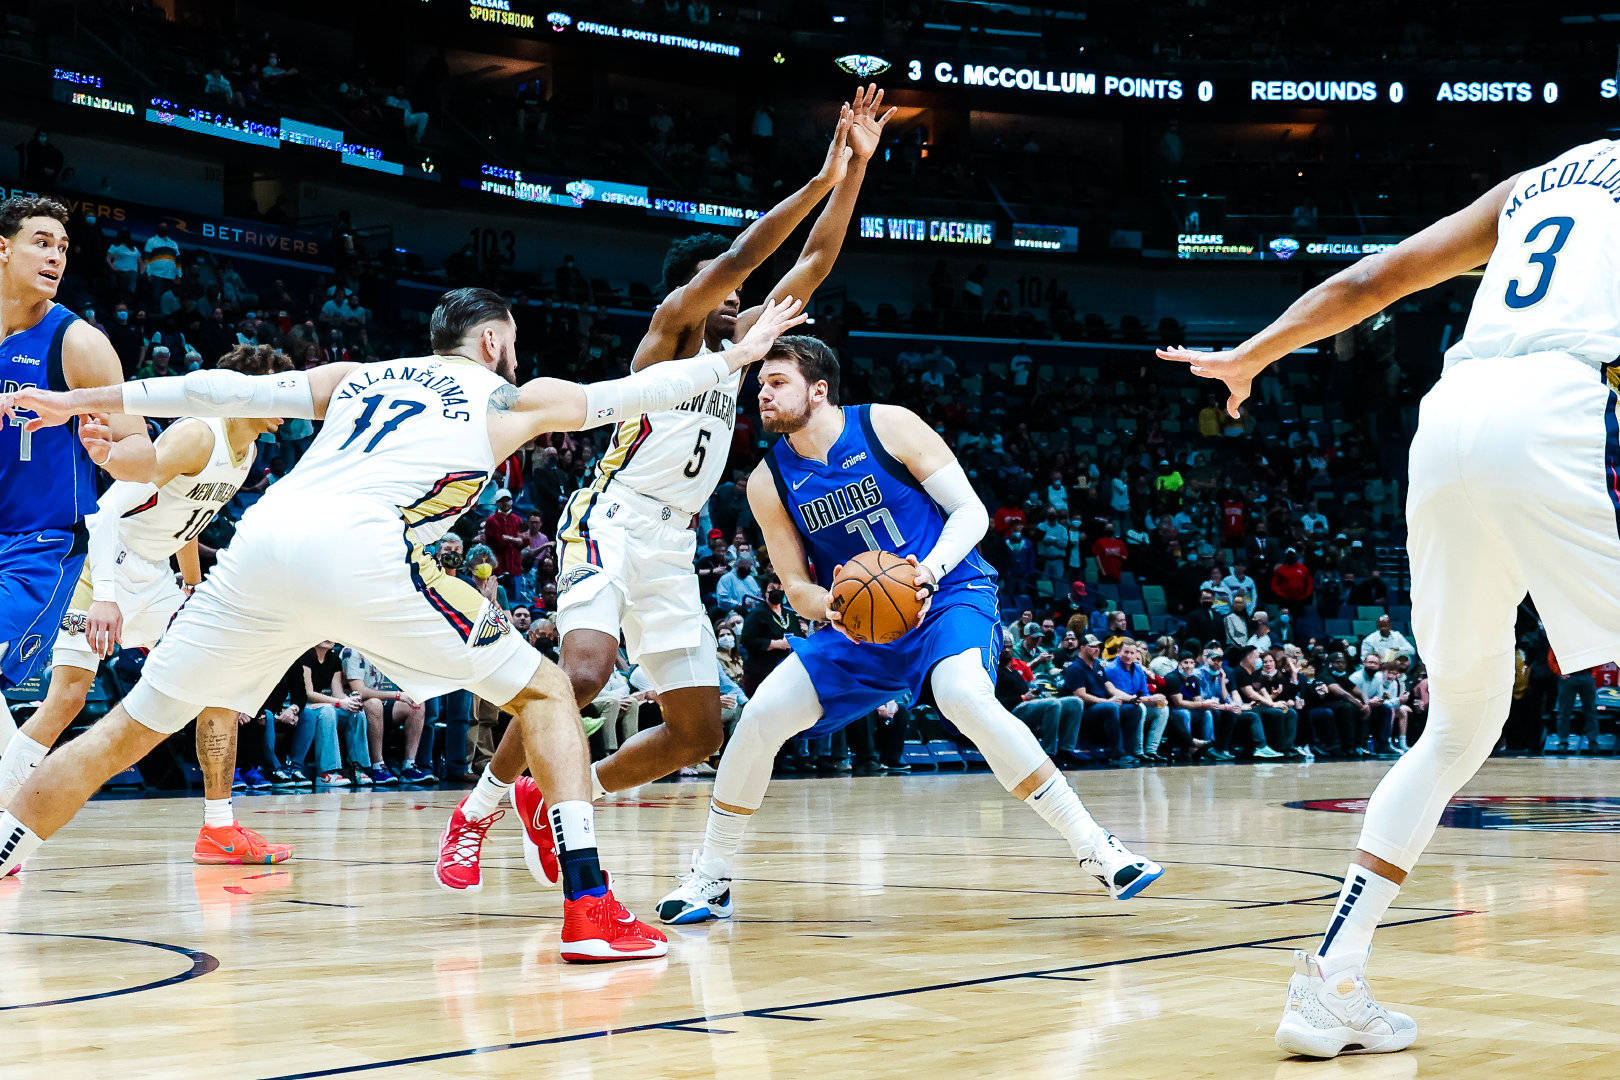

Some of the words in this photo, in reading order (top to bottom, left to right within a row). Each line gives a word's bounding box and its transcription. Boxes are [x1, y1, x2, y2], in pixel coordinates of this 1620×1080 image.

[470, 5, 535, 29] SPORTSBOOK
[577, 21, 619, 37] OFFICIAL
[621, 28, 658, 43] SPORTS
[659, 34, 699, 50] BETTING
[699, 40, 741, 57] PARTNER
[908, 60, 921, 80] 3
[935, 62, 958, 83] C.
[964, 64, 1096, 95] MCCOLLUM
[1104, 75, 1183, 100] POINTS
[1197, 80, 1213, 102] 0
[1251, 80, 1377, 102] REBOUNDS
[1389, 81, 1404, 103] 0
[1437, 81, 1533, 103] ASSISTS
[1543, 82, 1559, 104] 0
[601, 191, 652, 209] OFFICIAL
[654, 198, 697, 215] SPORTS
[698, 203, 744, 220] BETTING
[203, 221, 322, 261] BETRIVERS
[471, 227, 517, 267] 103
[888, 217, 926, 242] WITH
[930, 220, 993, 245] CAESARS
[1178, 233, 1224, 245] CAESARS
[1306, 242, 1361, 255] OFFICIAL
[1504, 215, 1577, 310] 3
[12, 353, 41, 367] chime
[338, 393, 428, 454] 17
[683, 428, 712, 480] 5
[842, 451, 869, 469] chime
[185, 482, 217, 501] NEW
[798, 474, 883, 535] DALLAS
[173, 507, 215, 543] 10
[844, 507, 906, 552] 77
